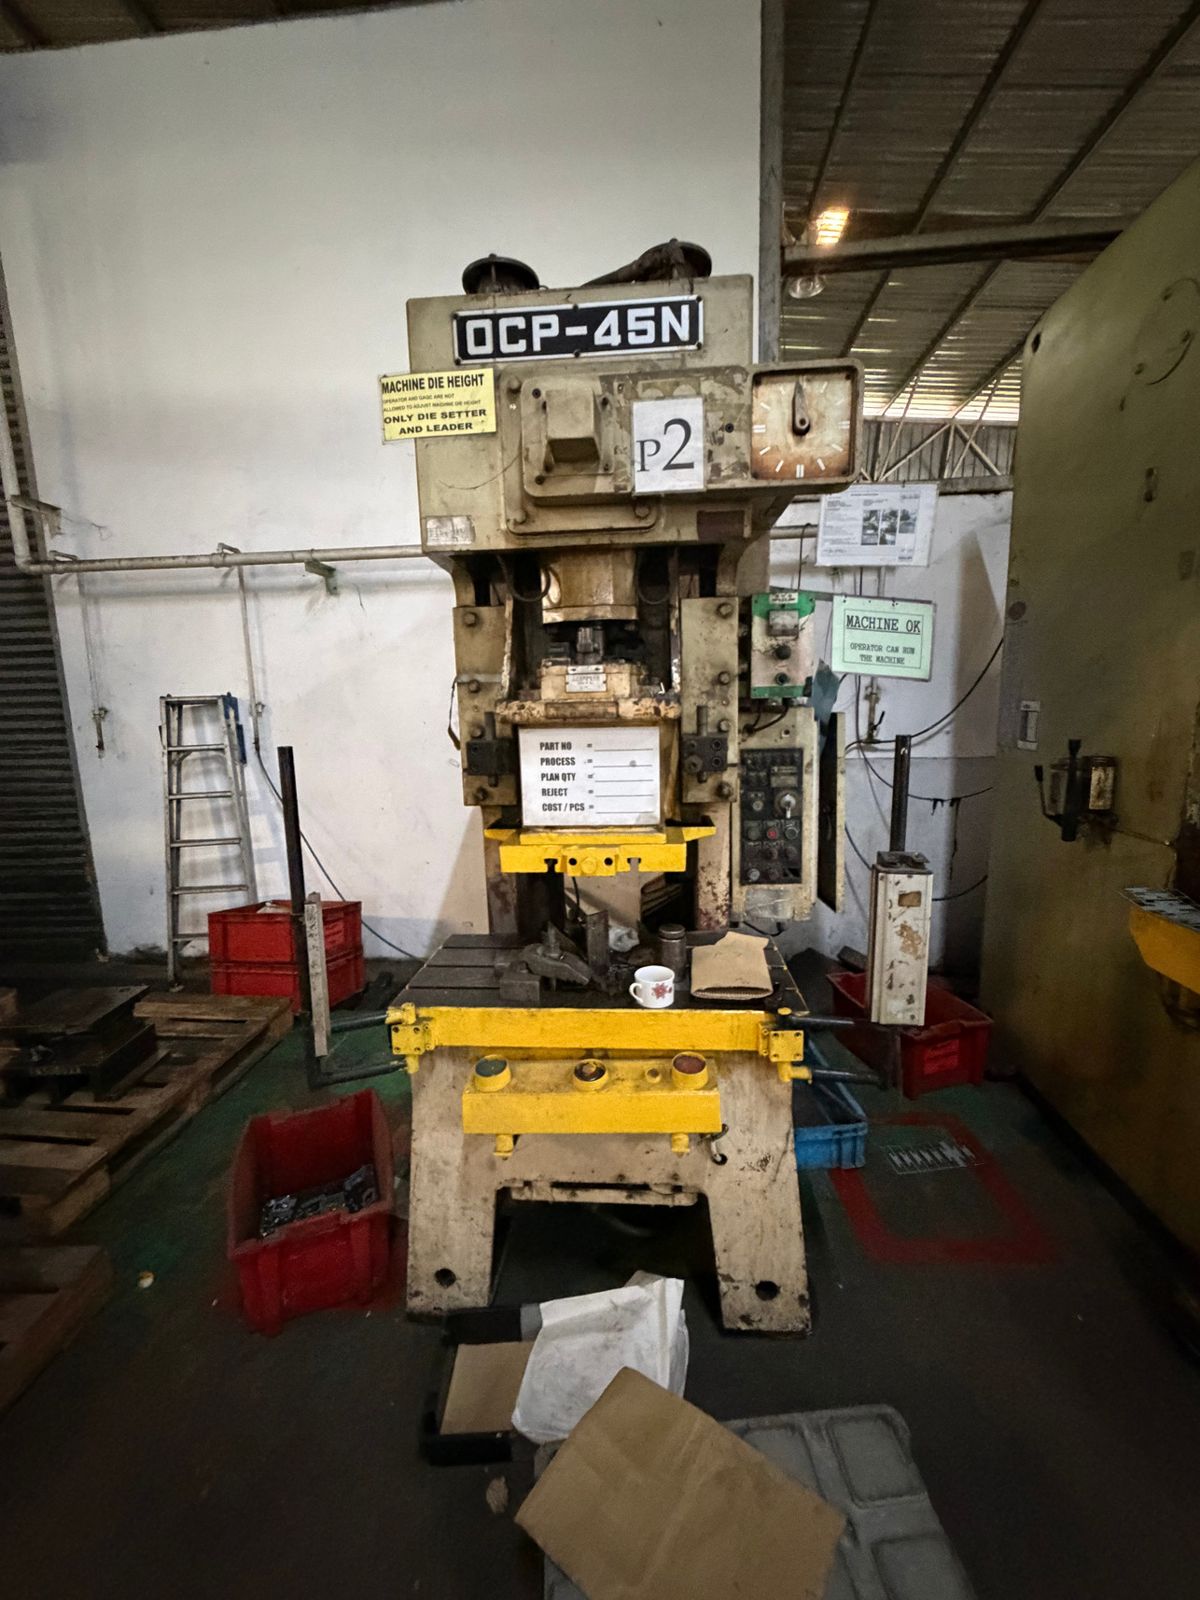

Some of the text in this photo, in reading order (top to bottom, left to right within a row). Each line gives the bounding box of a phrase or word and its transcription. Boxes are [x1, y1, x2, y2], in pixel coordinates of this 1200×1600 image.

[466, 304, 690, 355] OCP-45N
[382, 374, 484, 394] MACHINE DIE HEIGHT
[384, 409, 486, 424] ONLY DIE SETTER
[399, 422, 473, 435] AND LEADER
[636, 418, 695, 473] P2
[846, 615, 920, 633] MACHINE OK
[850, 642, 883, 652] OPERATOR
[886, 645, 899, 653] CAN
[860, 654, 905, 664] THE MACHINE
[540, 742, 560, 751] PART
[561, 742, 572, 750] NO
[540, 757, 576, 766] PROCESS
[541, 773, 560, 781] PLAN
[561, 773, 576, 781] QTY
[542, 788, 568, 796] REJECT
[542, 803, 562, 812] COST
[569, 803, 585, 812] PCS
